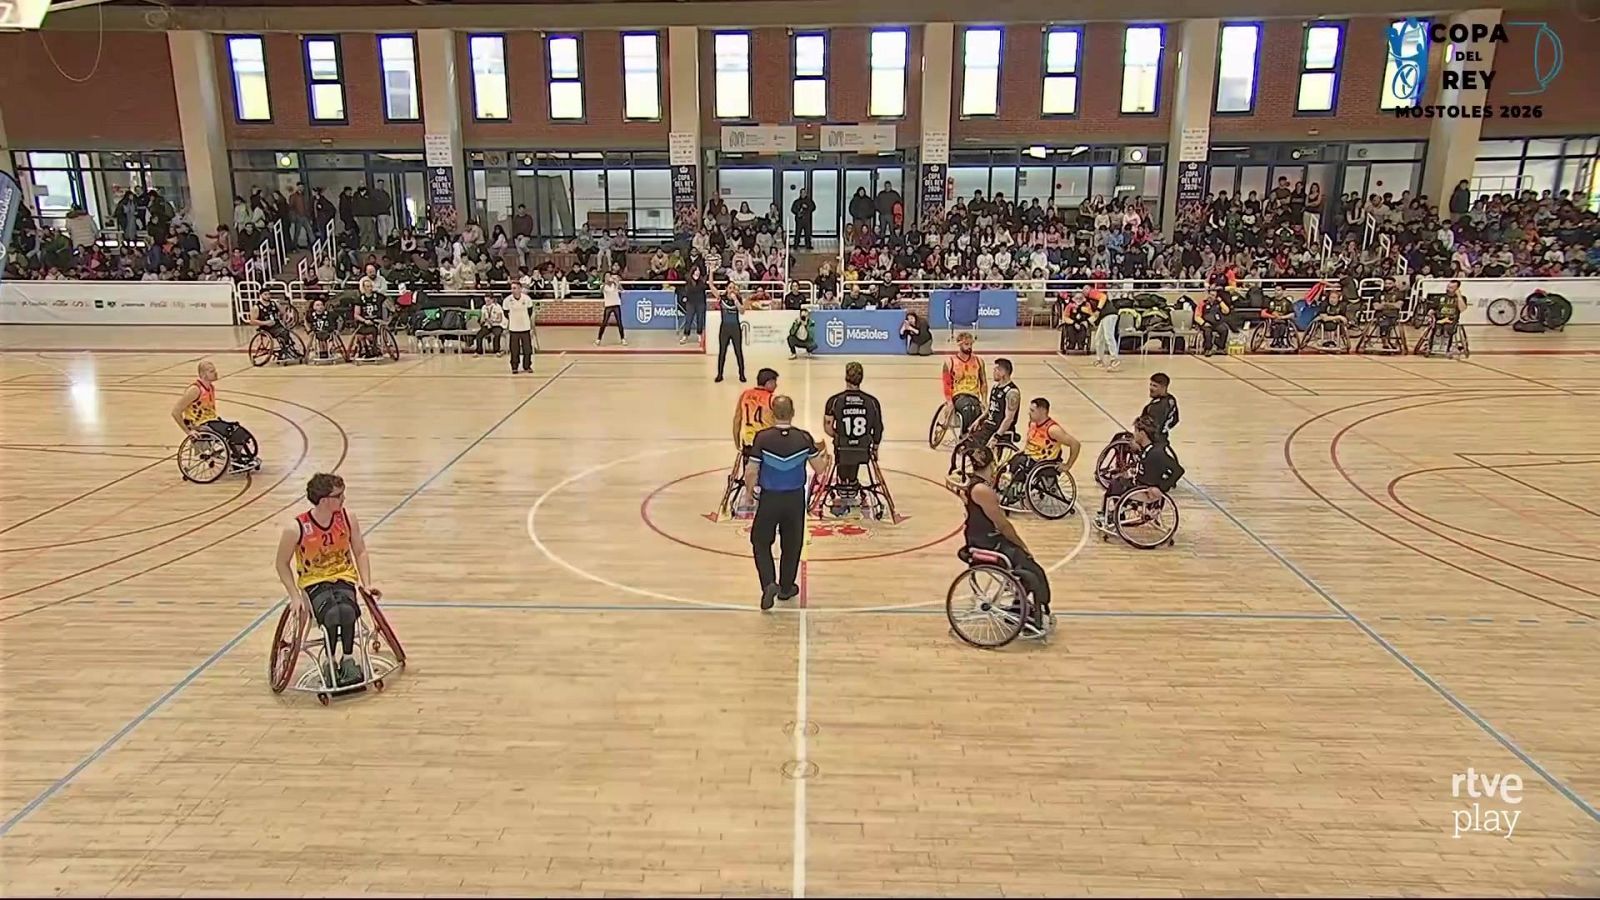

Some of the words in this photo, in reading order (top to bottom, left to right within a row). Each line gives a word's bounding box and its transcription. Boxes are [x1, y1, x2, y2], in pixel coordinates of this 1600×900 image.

[846, 328, 889, 340] Móstoles
[745, 403, 764, 427] 14
[842, 416, 867, 436] 18
[322, 532, 335, 547] 21
